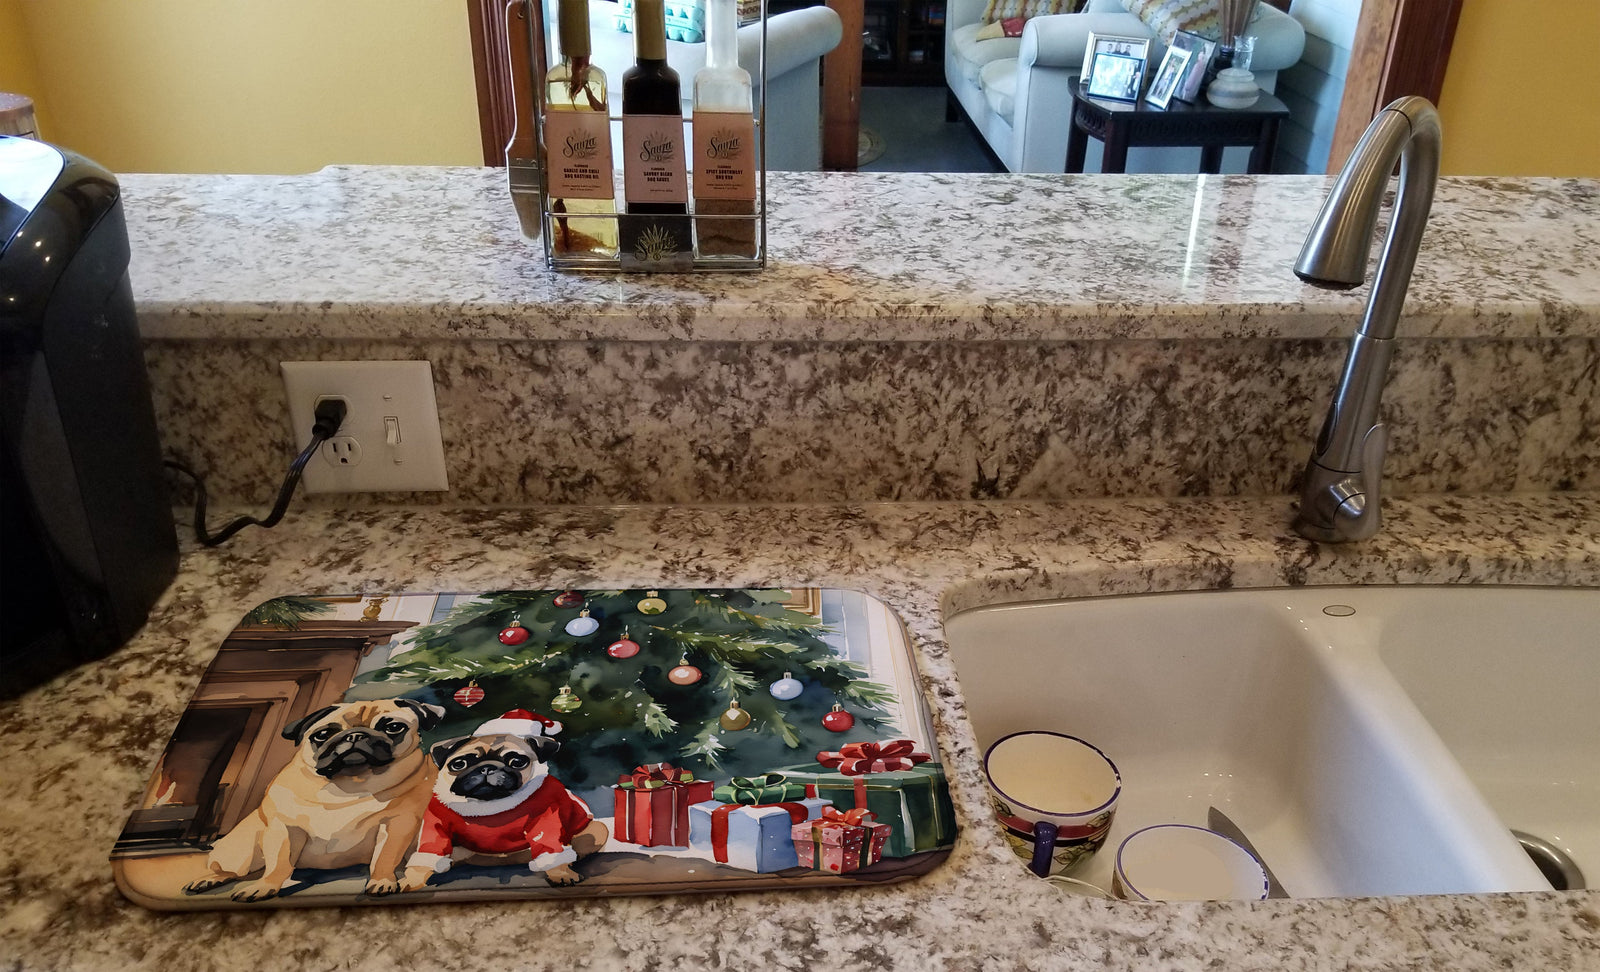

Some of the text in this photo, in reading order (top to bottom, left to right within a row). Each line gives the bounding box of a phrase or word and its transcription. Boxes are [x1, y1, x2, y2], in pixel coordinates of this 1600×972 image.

[563, 136, 597, 158] Sauza
[640, 140, 673, 162] Sauza
[707, 137, 740, 159] Sauza
